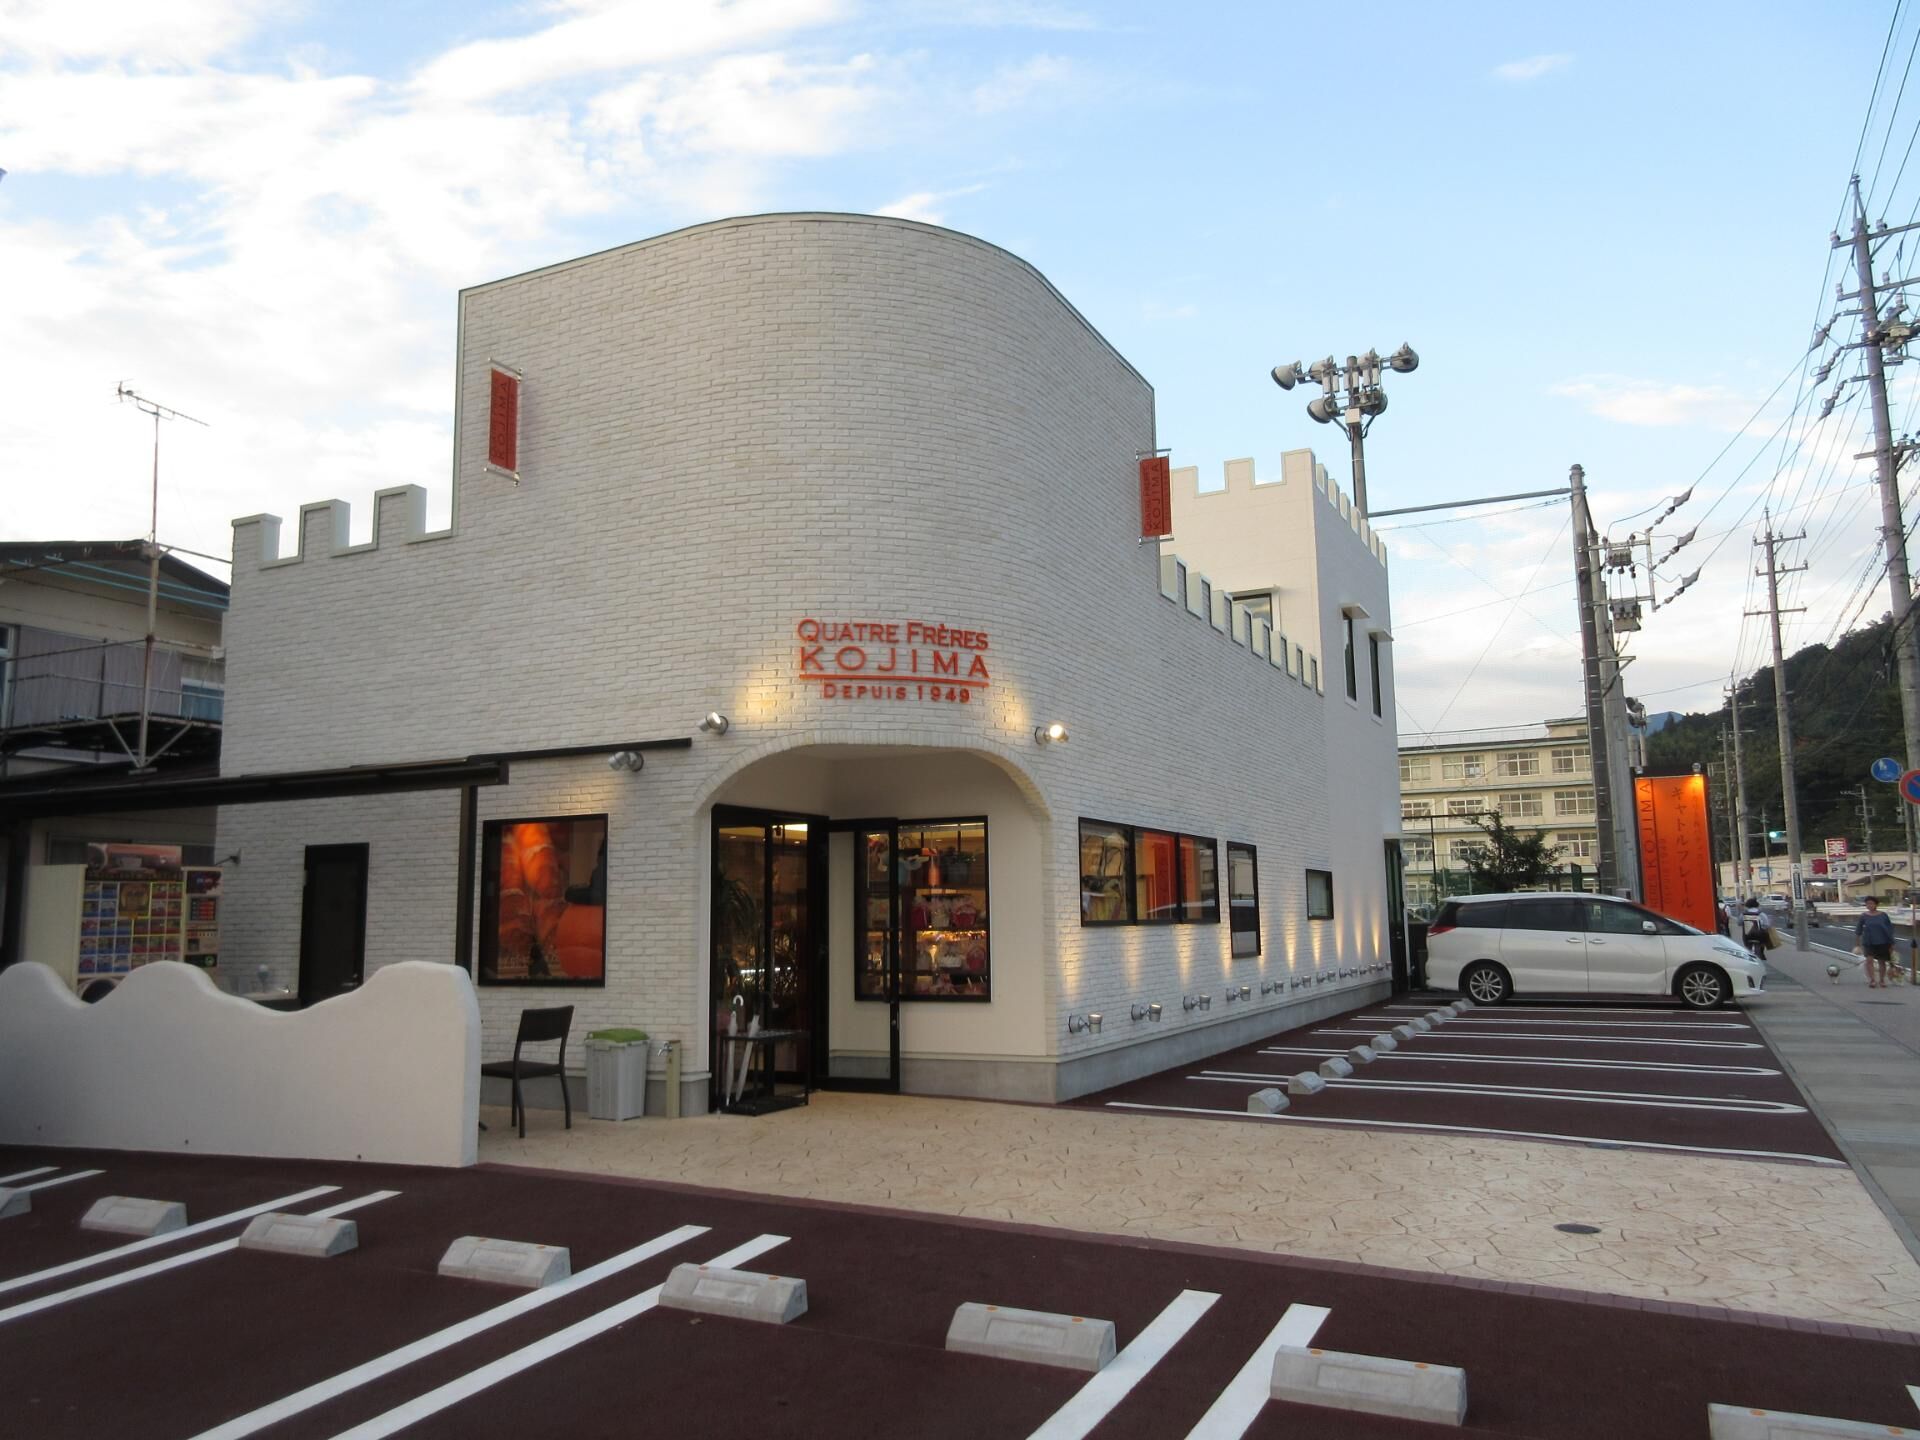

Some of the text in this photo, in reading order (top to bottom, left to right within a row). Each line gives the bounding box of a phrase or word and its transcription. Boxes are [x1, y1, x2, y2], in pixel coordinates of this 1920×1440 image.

[1152, 463, 1161, 530] KOJIMA
[798, 618, 988, 650] QUATRE FRÈRES
[800, 646, 990, 678] KOJIMA
[823, 683, 970, 703] DEPUIS 1949
[1640, 783, 1657, 868] KOJIMA
